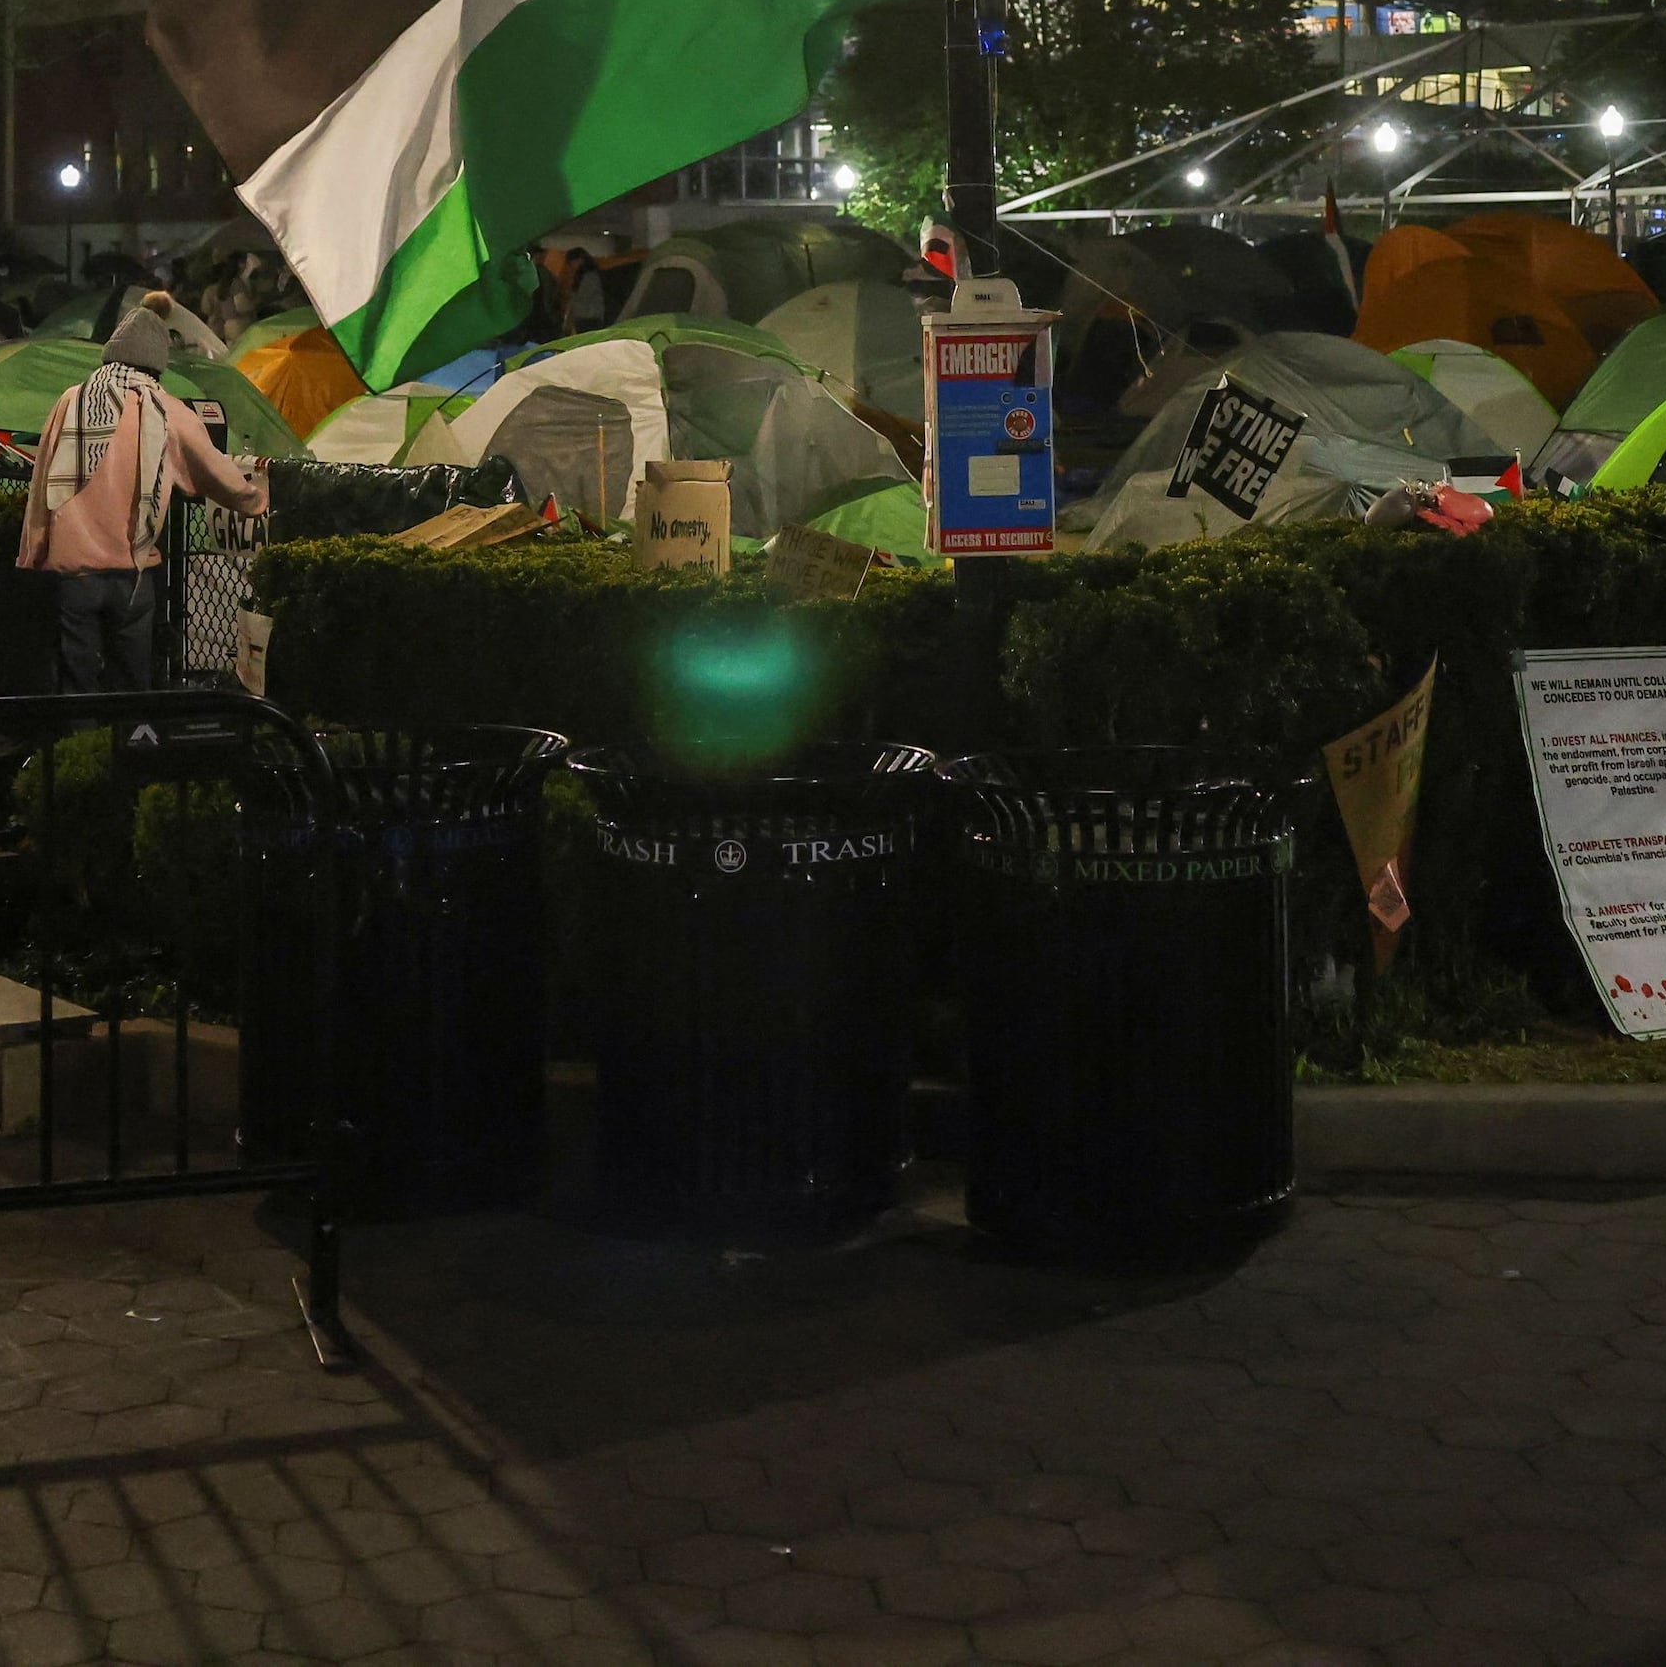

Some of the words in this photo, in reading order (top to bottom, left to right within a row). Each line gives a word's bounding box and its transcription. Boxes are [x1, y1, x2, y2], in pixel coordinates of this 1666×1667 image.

[940, 342, 1028, 375] EMERGEN
[651, 511, 667, 541] No
[944, 533, 982, 548] ACCESS
[985, 533, 997, 546] TO
[1000, 532, 1044, 546] SECURITY
[1531, 680, 1545, 690] WE
[1549, 680, 1572, 690] WILL
[1575, 678, 1611, 689] REMAIN
[1614, 678, 1642, 688] UNTIL
[1543, 692, 1596, 704] CONCEDES
[1599, 691, 1611, 701] TO
[1614, 690, 1634, 701] OUR
[1342, 694, 1425, 779] STAFF
[1541, 738, 1550, 748] 1.
[1553, 736, 1585, 748] DIVEST
[1590, 734, 1608, 745] ALL
[1609, 732, 1661, 744] FINANCES,
[1543, 751, 1559, 762] the
[1621, 746, 1645, 756] from
[1549, 764, 1570, 774] that
[1571, 761, 1599, 773] profit
[1601, 760, 1625, 770] from
[1627, 758, 1656, 769] Israeli
[1613, 772, 1631, 784] and
[596, 829, 677, 866] TRASH
[781, 831, 895, 866] TRASH
[1557, 844, 1567, 854] 2.
[1569, 838, 1623, 852] COMPLETE
[1563, 856, 1573, 867] of
[1575, 852, 1630, 866] Columbia's
[1076, 857, 1177, 883] MIXED
[1186, 854, 1263, 881] PAPER
[1585, 907, 1597, 918] 3.
[1599, 902, 1647, 916] AMNESTY
[1649, 900, 1665, 911] for
[1590, 918, 1627, 930] faculty
[1587, 928, 1641, 943] movement
[1643, 926, 1659, 936] for
